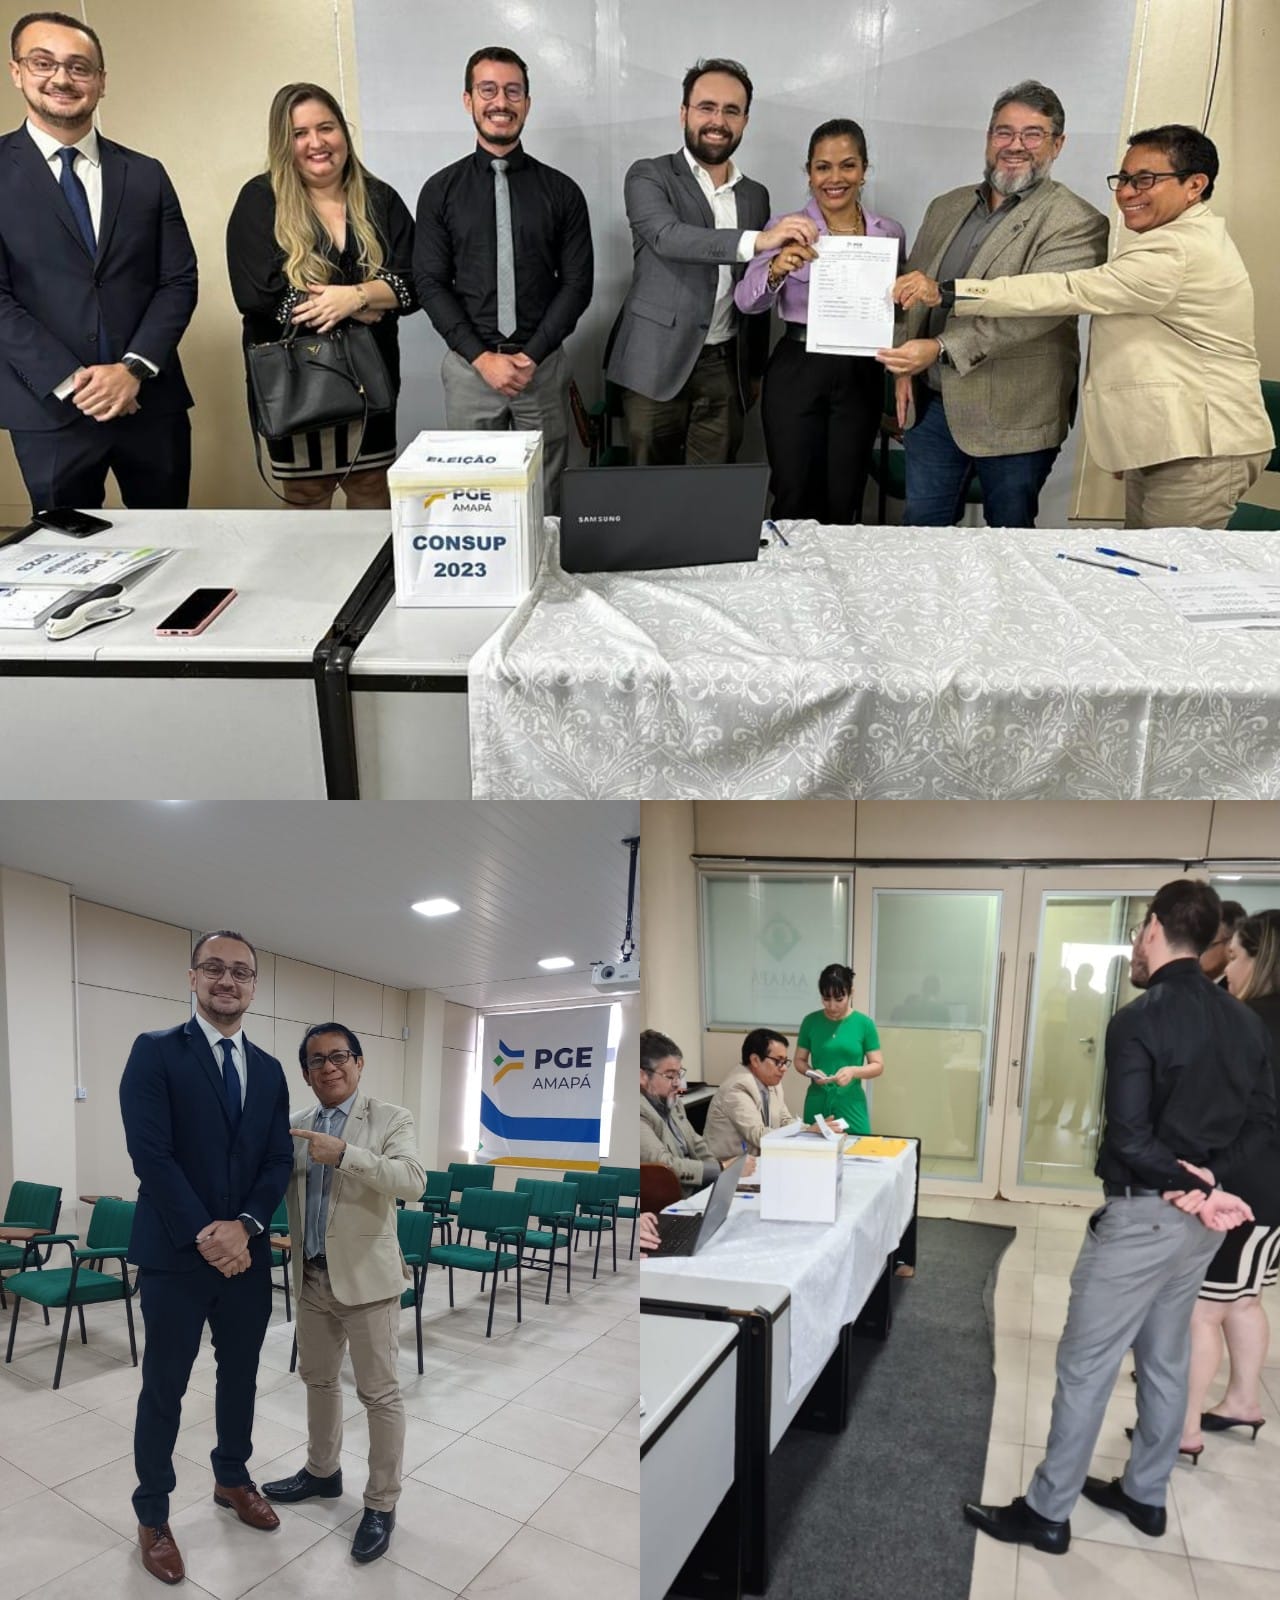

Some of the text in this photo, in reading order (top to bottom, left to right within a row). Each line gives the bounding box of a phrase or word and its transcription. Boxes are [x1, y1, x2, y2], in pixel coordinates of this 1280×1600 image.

[427, 455, 497, 464] ELEIÇÃO
[453, 488, 492, 501] PGE
[452, 502, 493, 512] AMAPÁ
[578, 515, 621, 523] SAMSUNG
[412, 535, 507, 551] CONSUP
[433, 562, 487, 577] 2023
[534, 1046, 593, 1069] PGE
[531, 1073, 592, 1090] AMAPÁ
